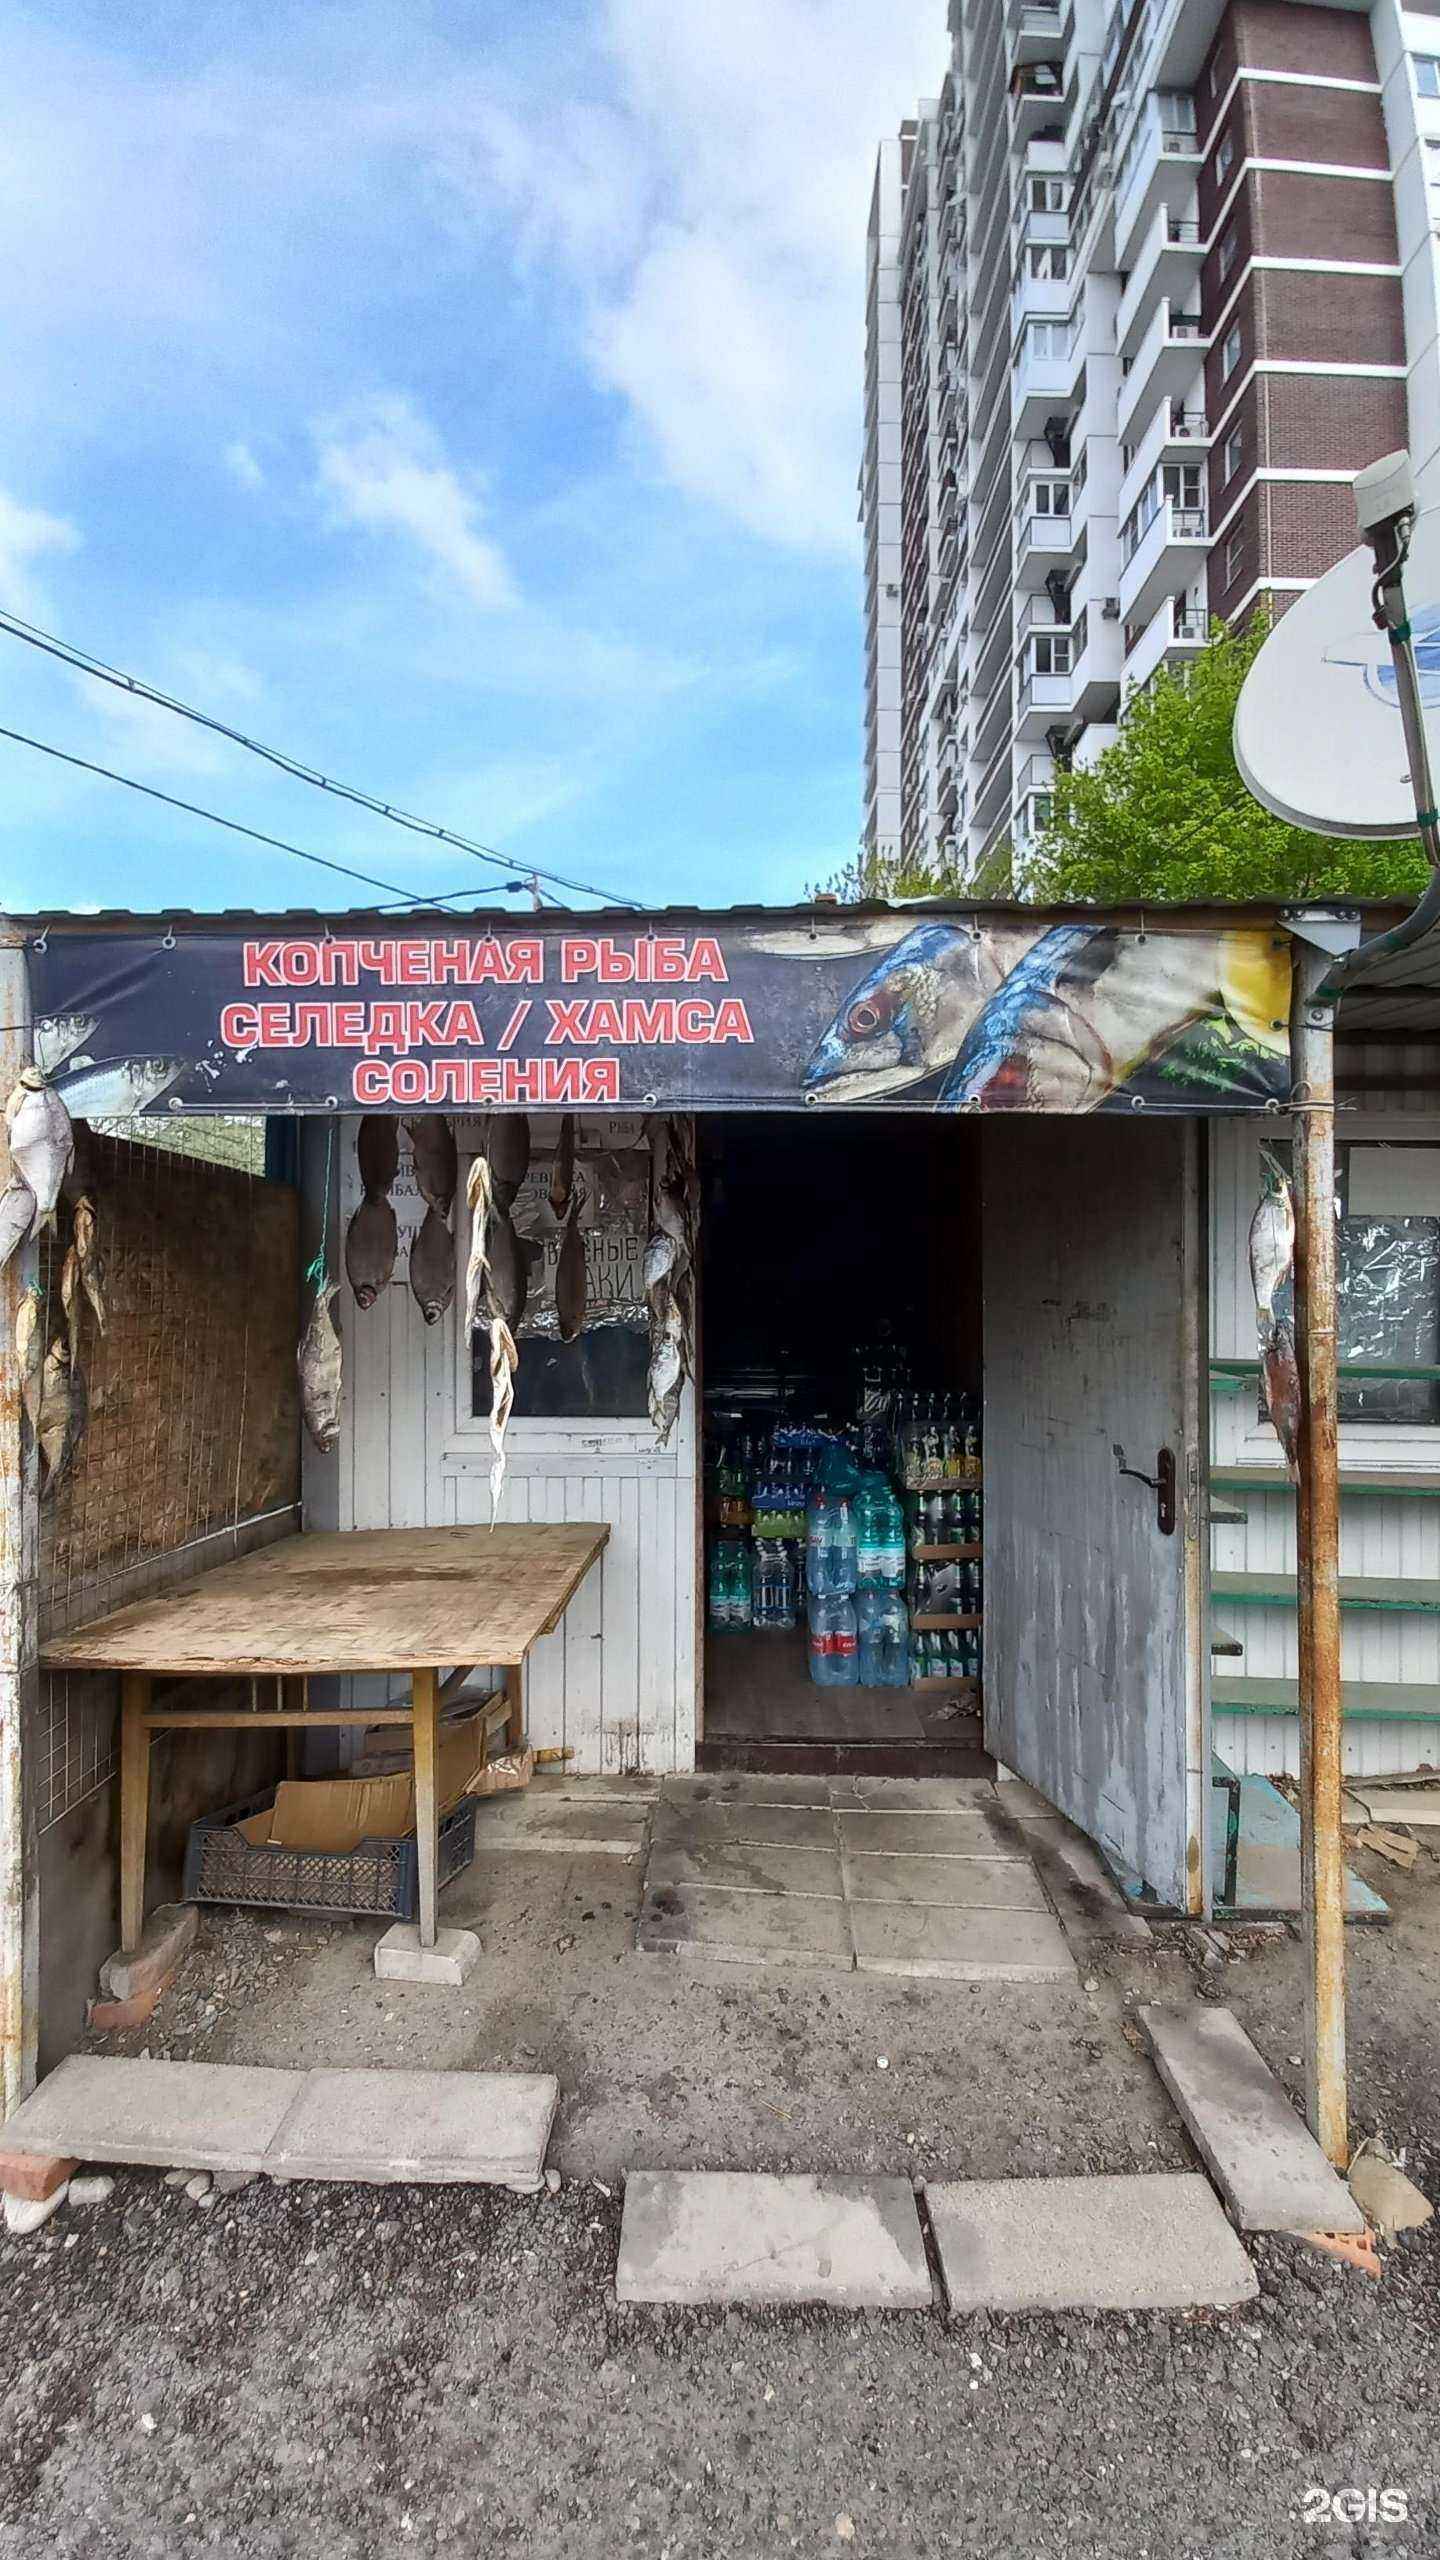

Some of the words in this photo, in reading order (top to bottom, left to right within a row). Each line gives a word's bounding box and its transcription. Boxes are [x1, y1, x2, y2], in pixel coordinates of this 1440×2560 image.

[243, 939, 544, 987] КОПЧЕНАЯ
[561, 937, 729, 983] РЫБА
[221, 1001, 485, 1055] СЕЛЕДКА
[544, 998, 754, 1045] ХАМСА
[353, 1057, 620, 1104] СОЛЕНИЯ
